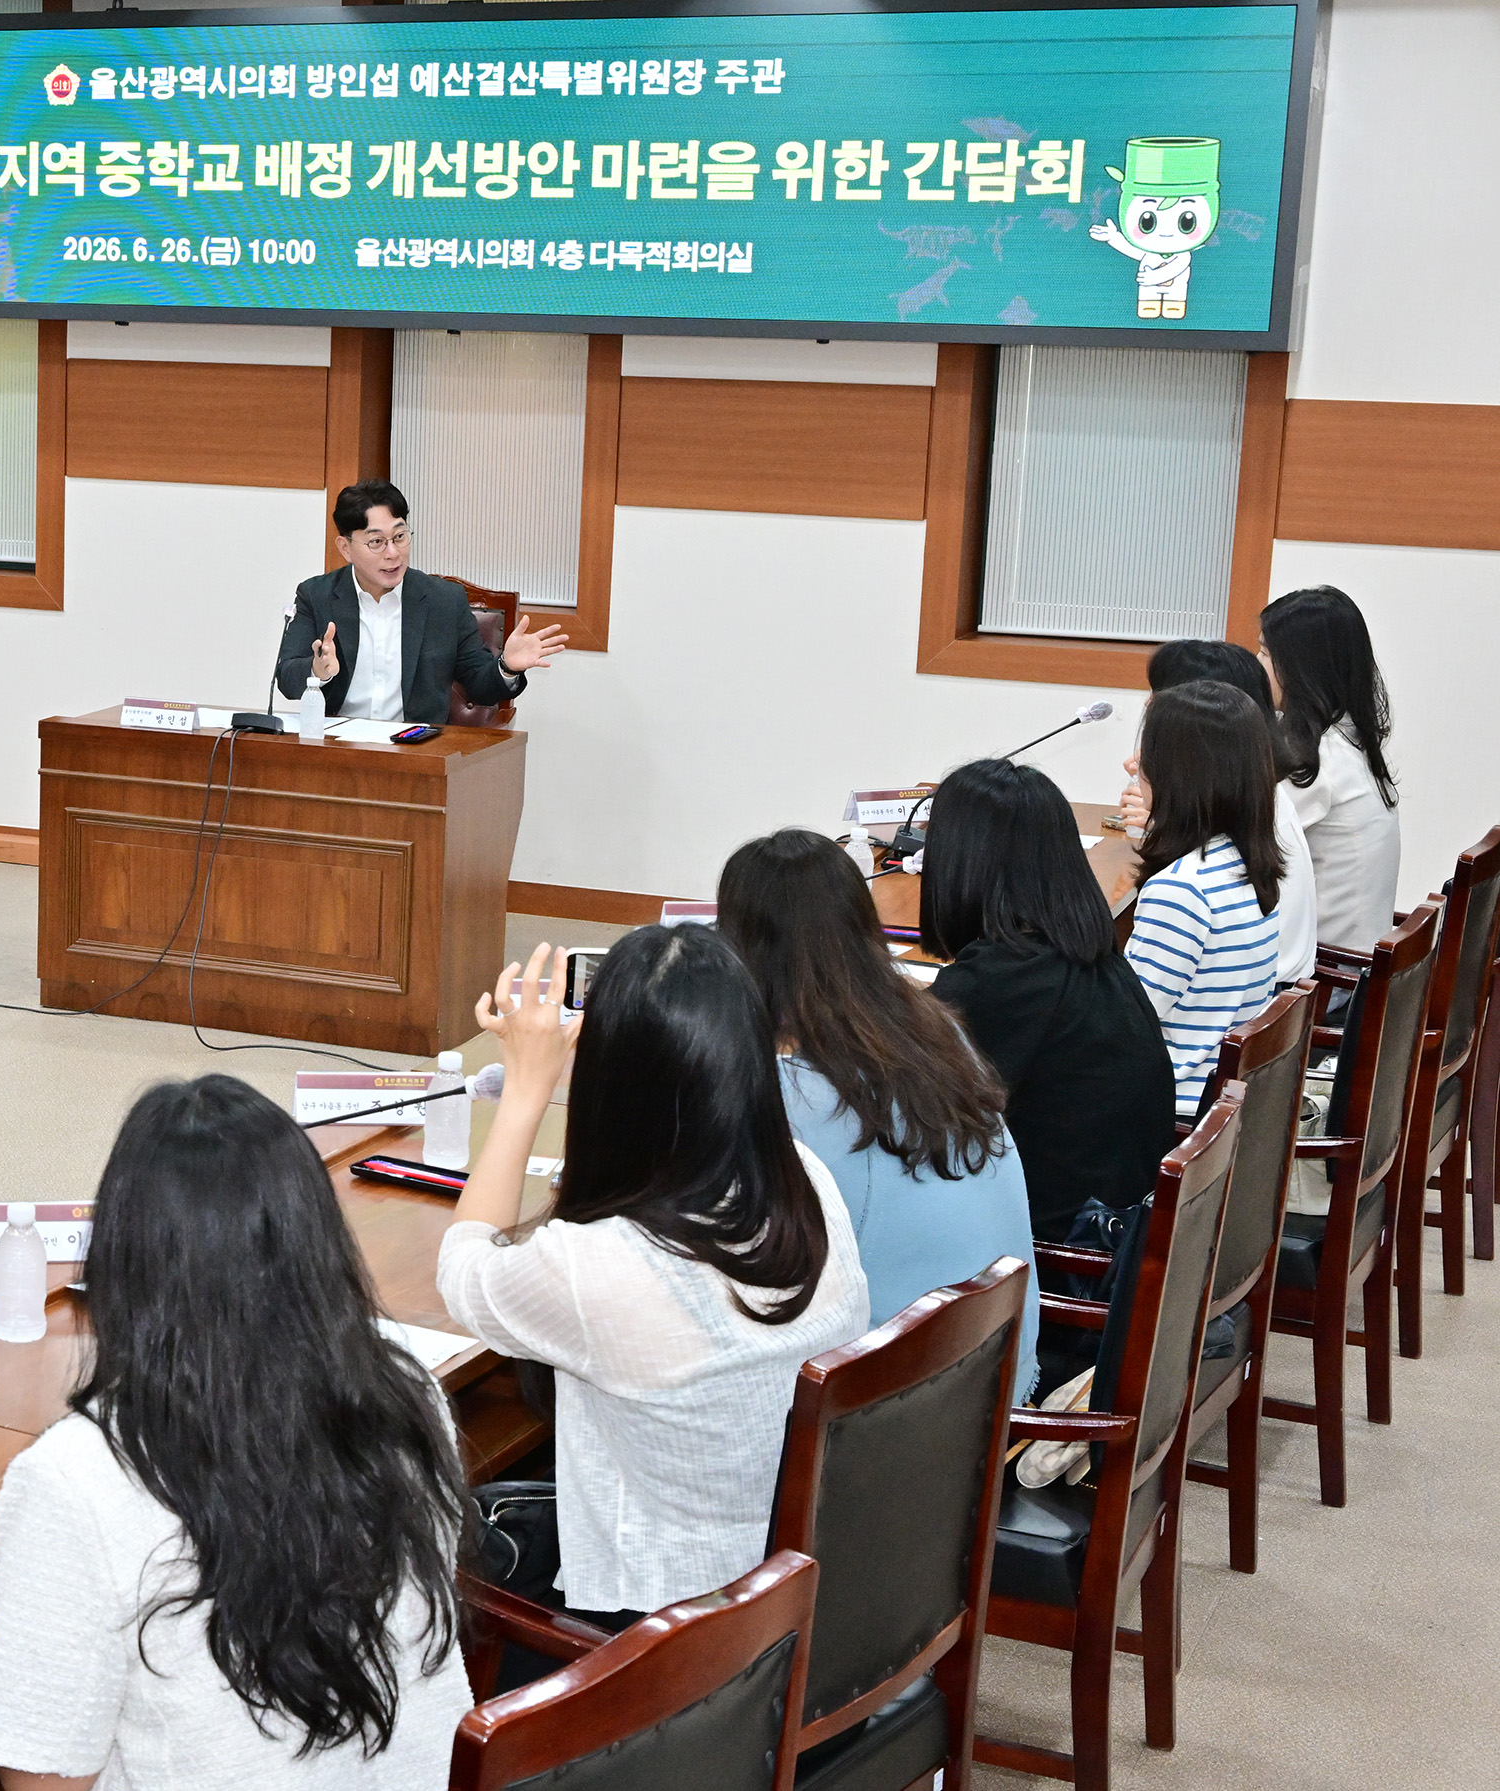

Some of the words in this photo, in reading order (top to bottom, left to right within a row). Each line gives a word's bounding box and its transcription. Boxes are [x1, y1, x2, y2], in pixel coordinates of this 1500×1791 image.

[51, 79, 72, 92] 의회
[88, 65, 297, 100] 울산광역시의회
[306, 62, 399, 98] 방인섭
[409, 59, 707, 97] 예산결산특별위원장
[714, 57, 786, 96] 주관
[95, 140, 244, 198] 중학교
[254, 140, 353, 199] 배정
[366, 139, 581, 200] 개선방안
[591, 139, 761, 201] 마련을
[771, 138, 890, 202] 위한
[902, 138, 1086, 204] 간담회
[62, 236, 128, 261] 2026.
[132, 237, 156, 262] 6.
[160, 235, 242, 266] 26.(금)
[247, 238, 317, 265] 10:00
[354, 237, 535, 270] 울산광역시의회
[539, 239, 586, 271] 4층
[588, 240, 754, 274] 다목적회의실
